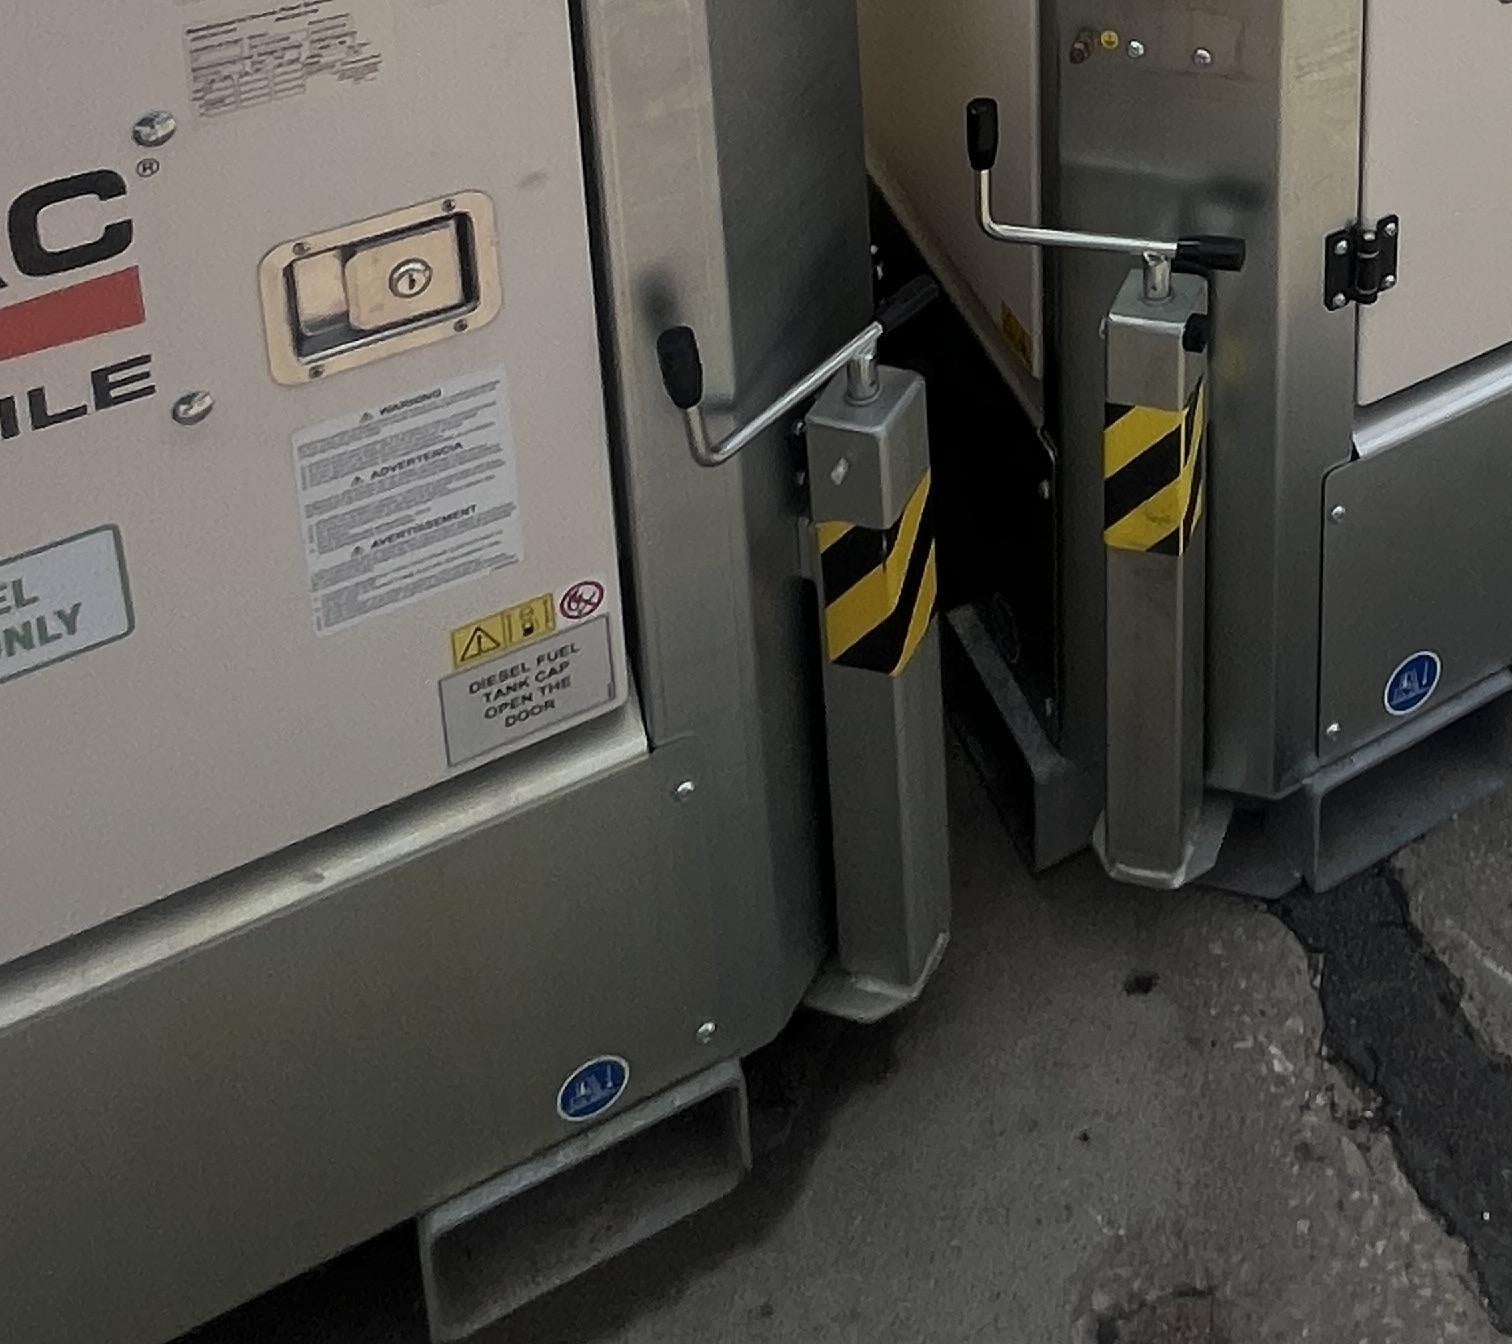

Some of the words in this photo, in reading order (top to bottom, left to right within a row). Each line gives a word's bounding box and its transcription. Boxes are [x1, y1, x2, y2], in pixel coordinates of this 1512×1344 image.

[0, 602, 83, 657] NLY
[468, 662, 531, 695] DIESEL
[536, 641, 581, 667] FUEL
[482, 679, 530, 704] TANK
[534, 659, 570, 684] CAP
[484, 692, 534, 720] OPEN
[538, 674, 572, 697] THE
[504, 699, 557, 728] DOOR
